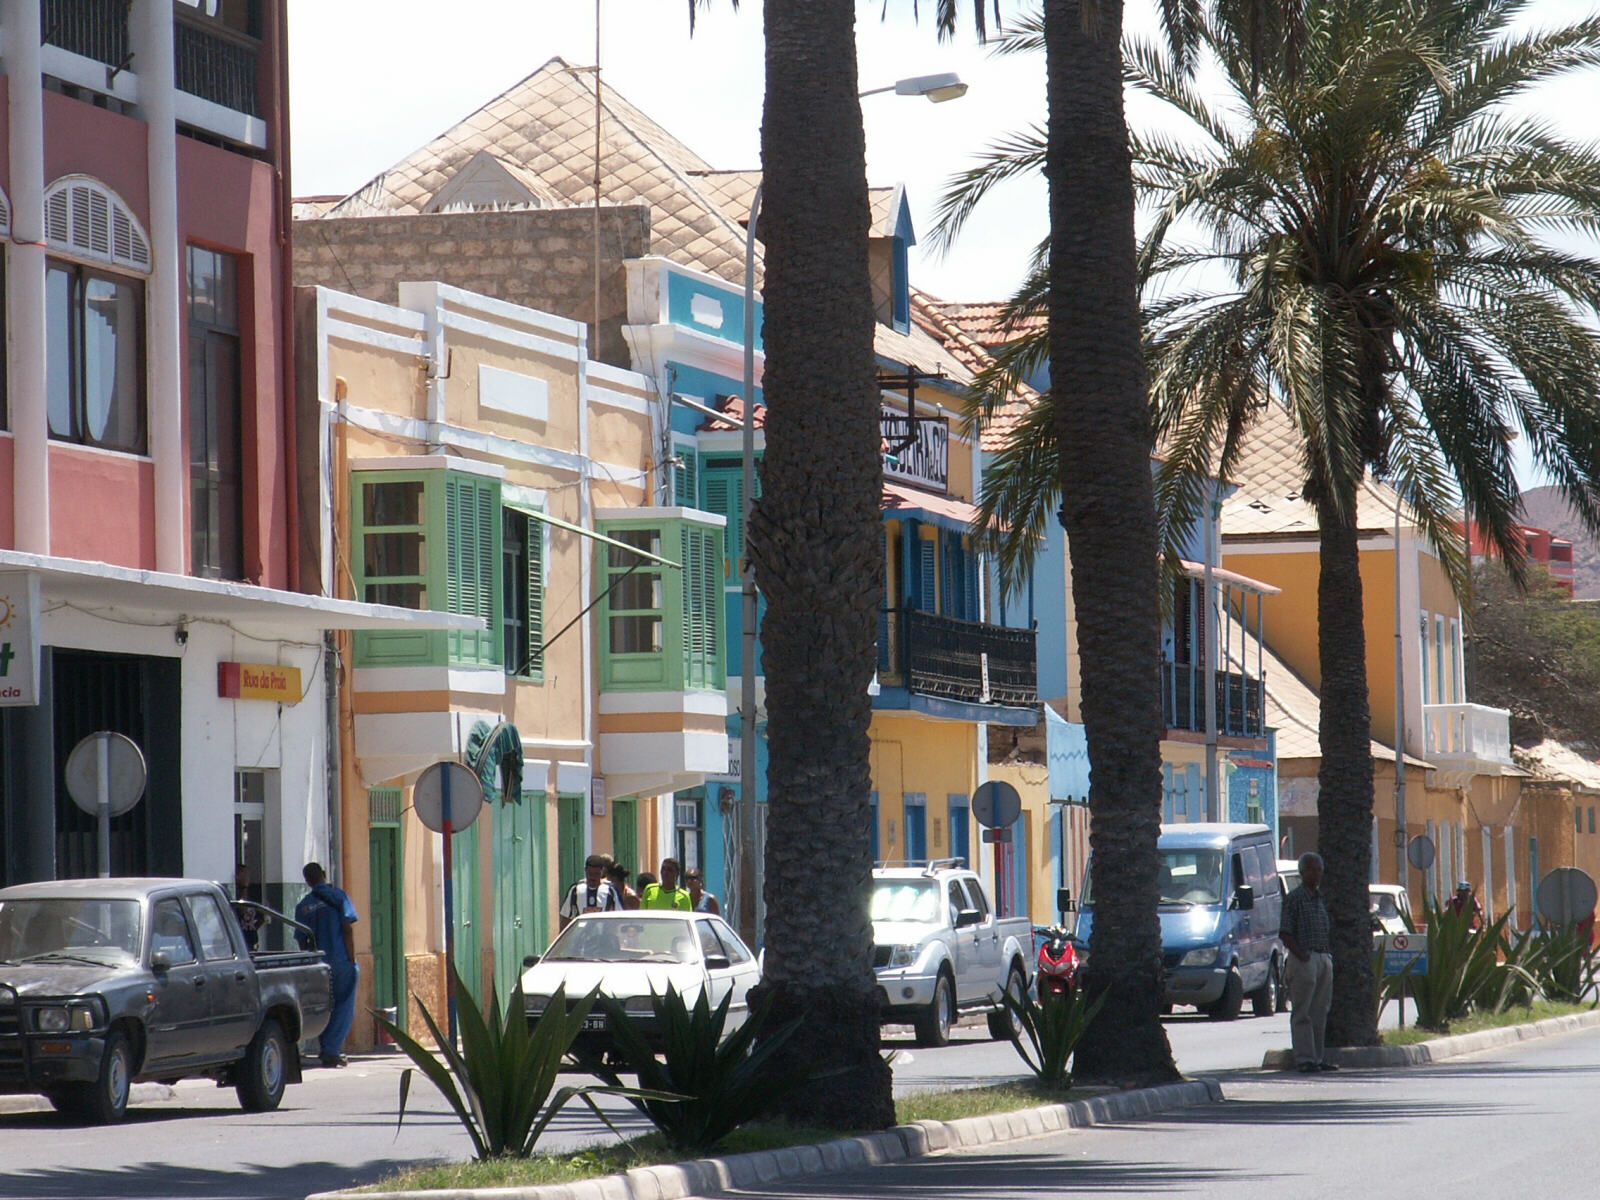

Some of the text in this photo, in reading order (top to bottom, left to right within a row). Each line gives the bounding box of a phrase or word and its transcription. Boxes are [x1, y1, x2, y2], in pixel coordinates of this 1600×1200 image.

[243, 670, 287, 690] Rua da Praia
[0, 686, 21, 698] cia
